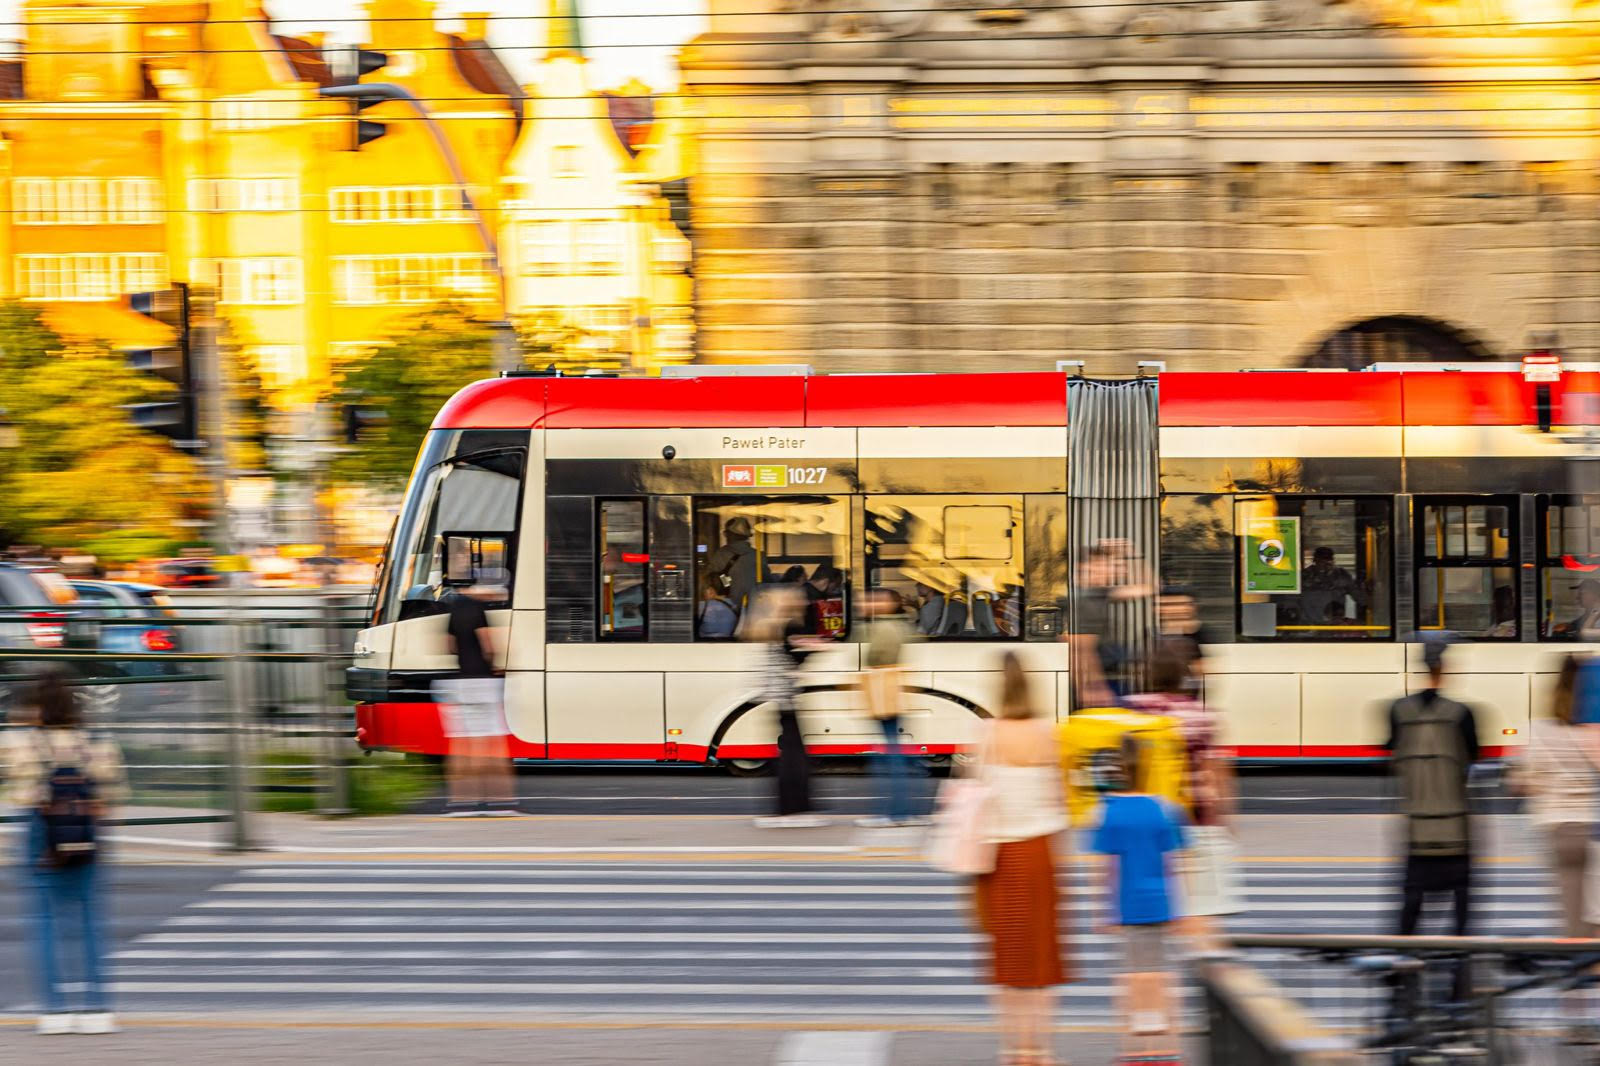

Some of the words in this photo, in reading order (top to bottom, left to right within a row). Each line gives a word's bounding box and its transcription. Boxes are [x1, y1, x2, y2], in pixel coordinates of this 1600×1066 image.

[722, 436, 764, 449] Paweł
[768, 436, 806, 449] Pater
[787, 467, 828, 484] 1027
